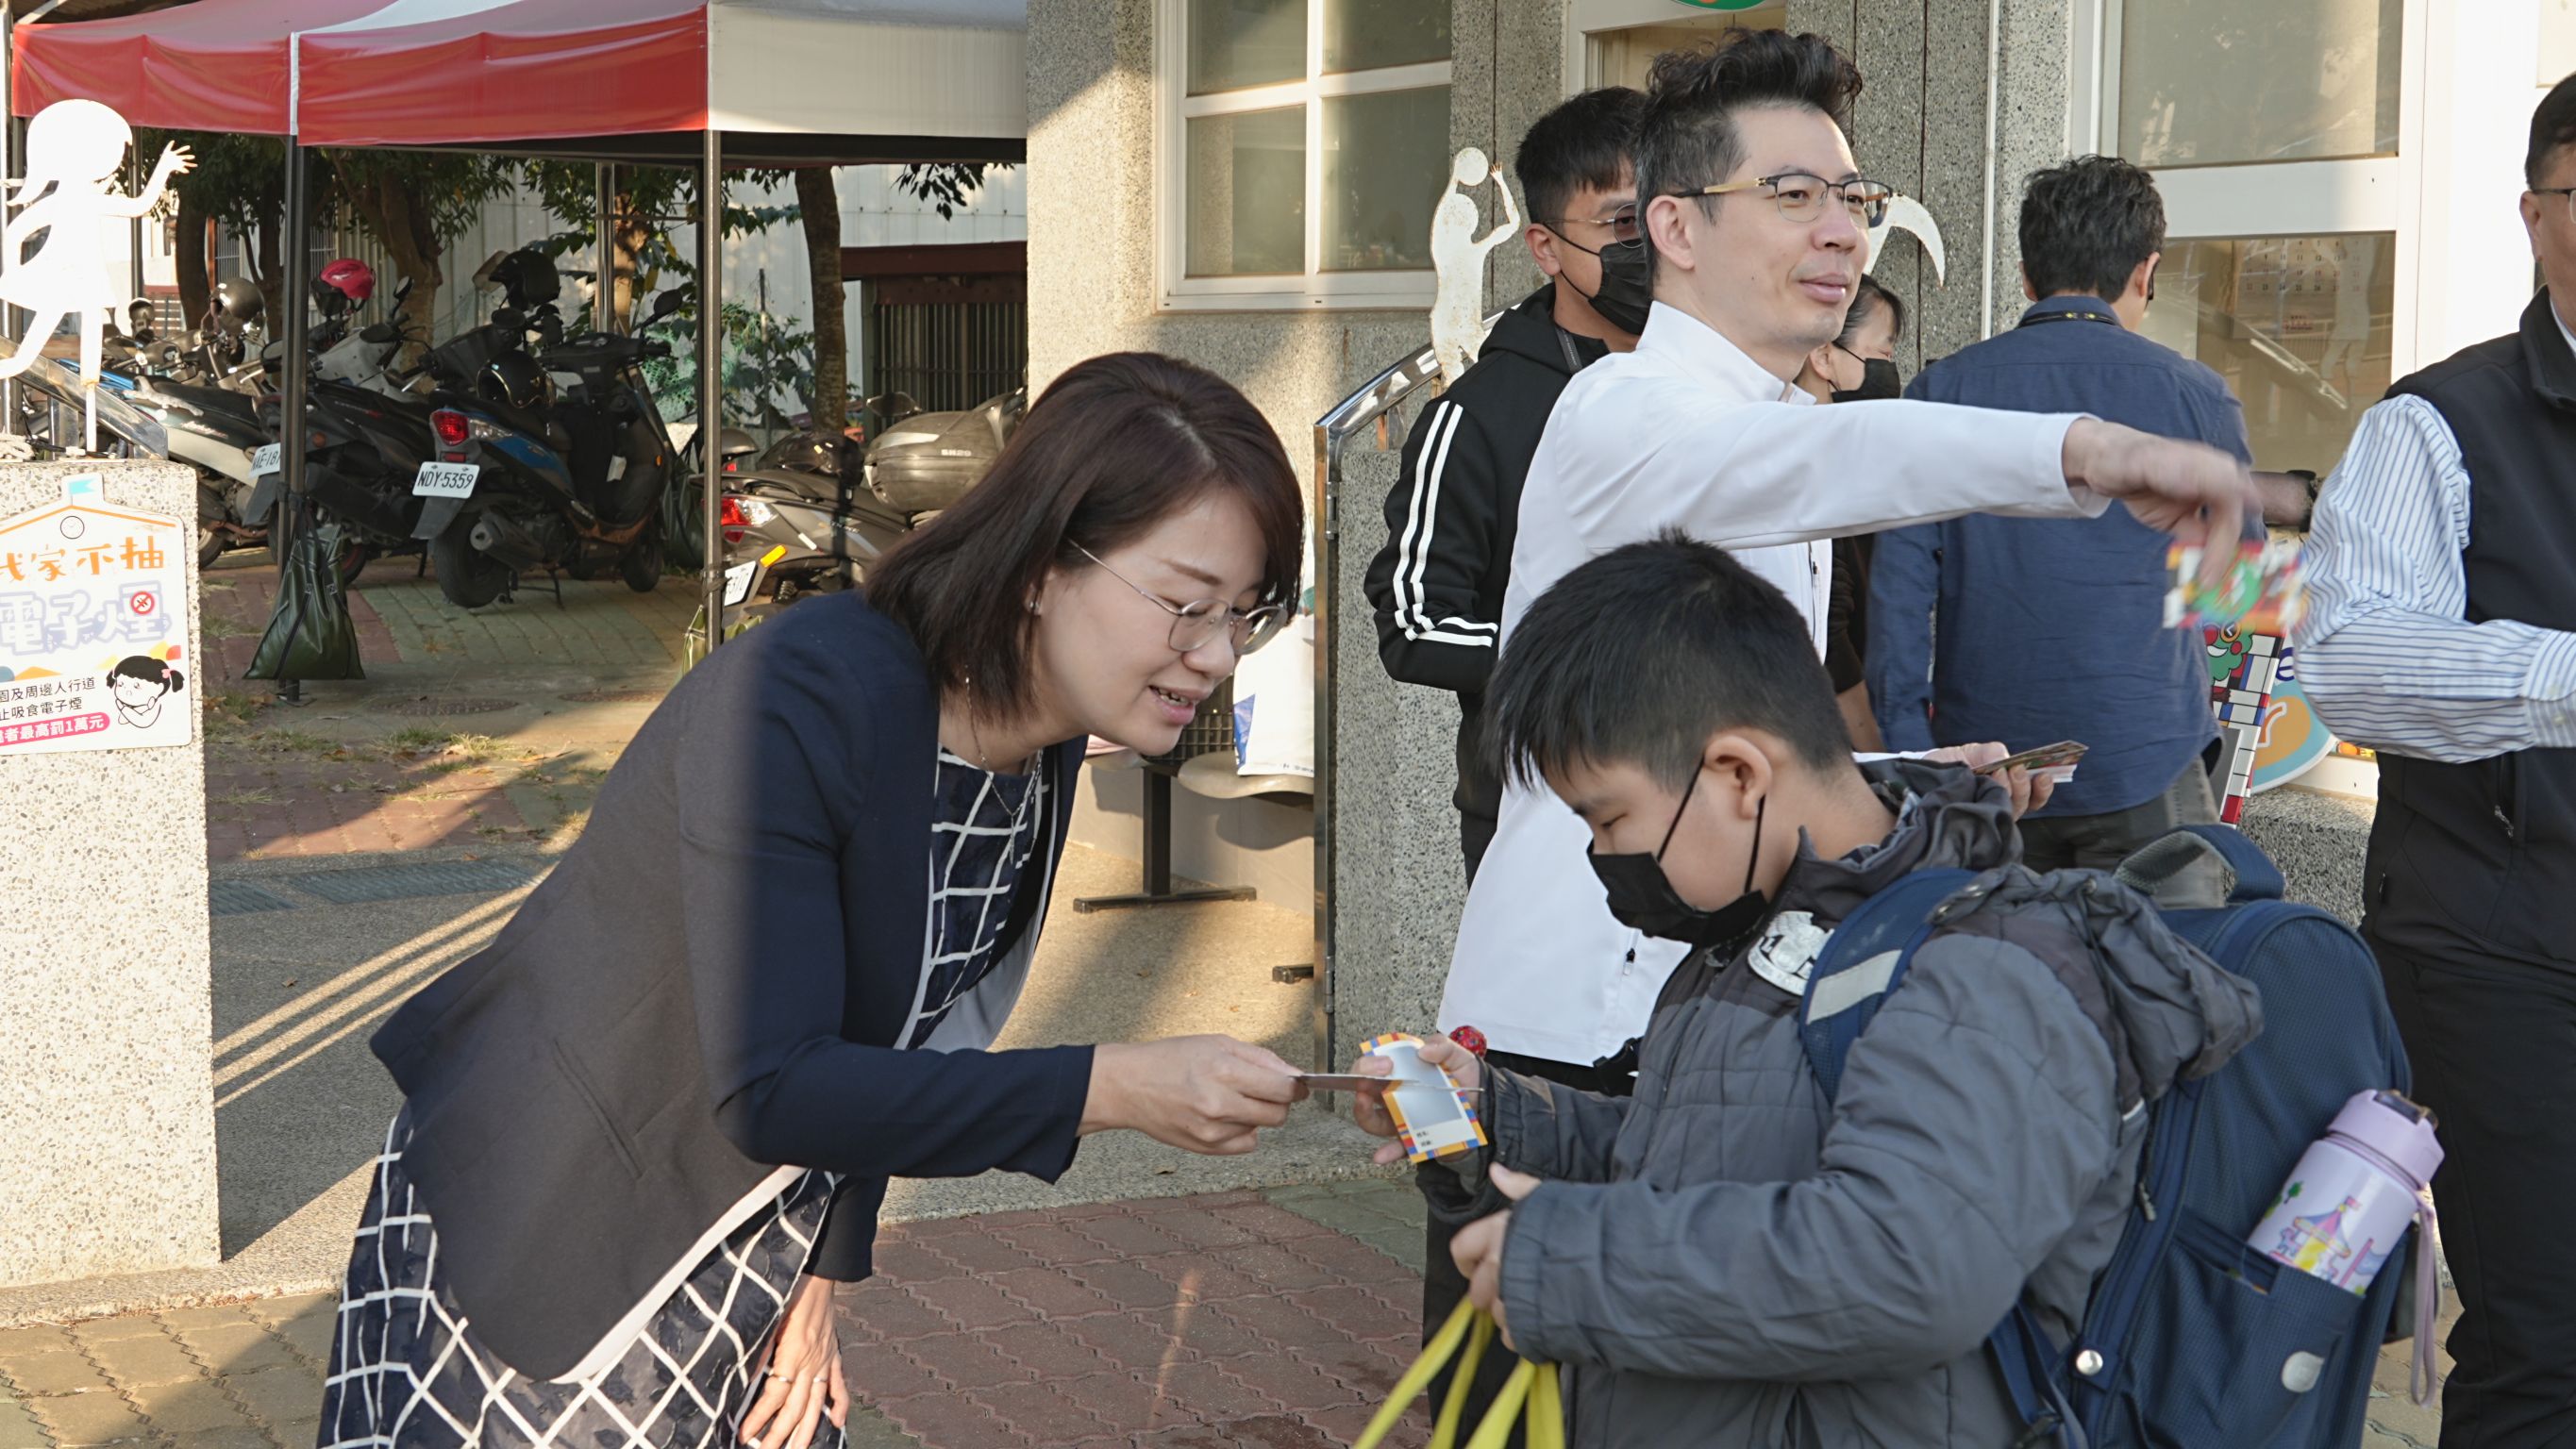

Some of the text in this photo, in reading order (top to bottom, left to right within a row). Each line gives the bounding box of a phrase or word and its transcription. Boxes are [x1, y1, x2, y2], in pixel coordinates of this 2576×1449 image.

[417, 471, 475, 489] NDY-5359
[0, 581, 172, 656] 電子煙
